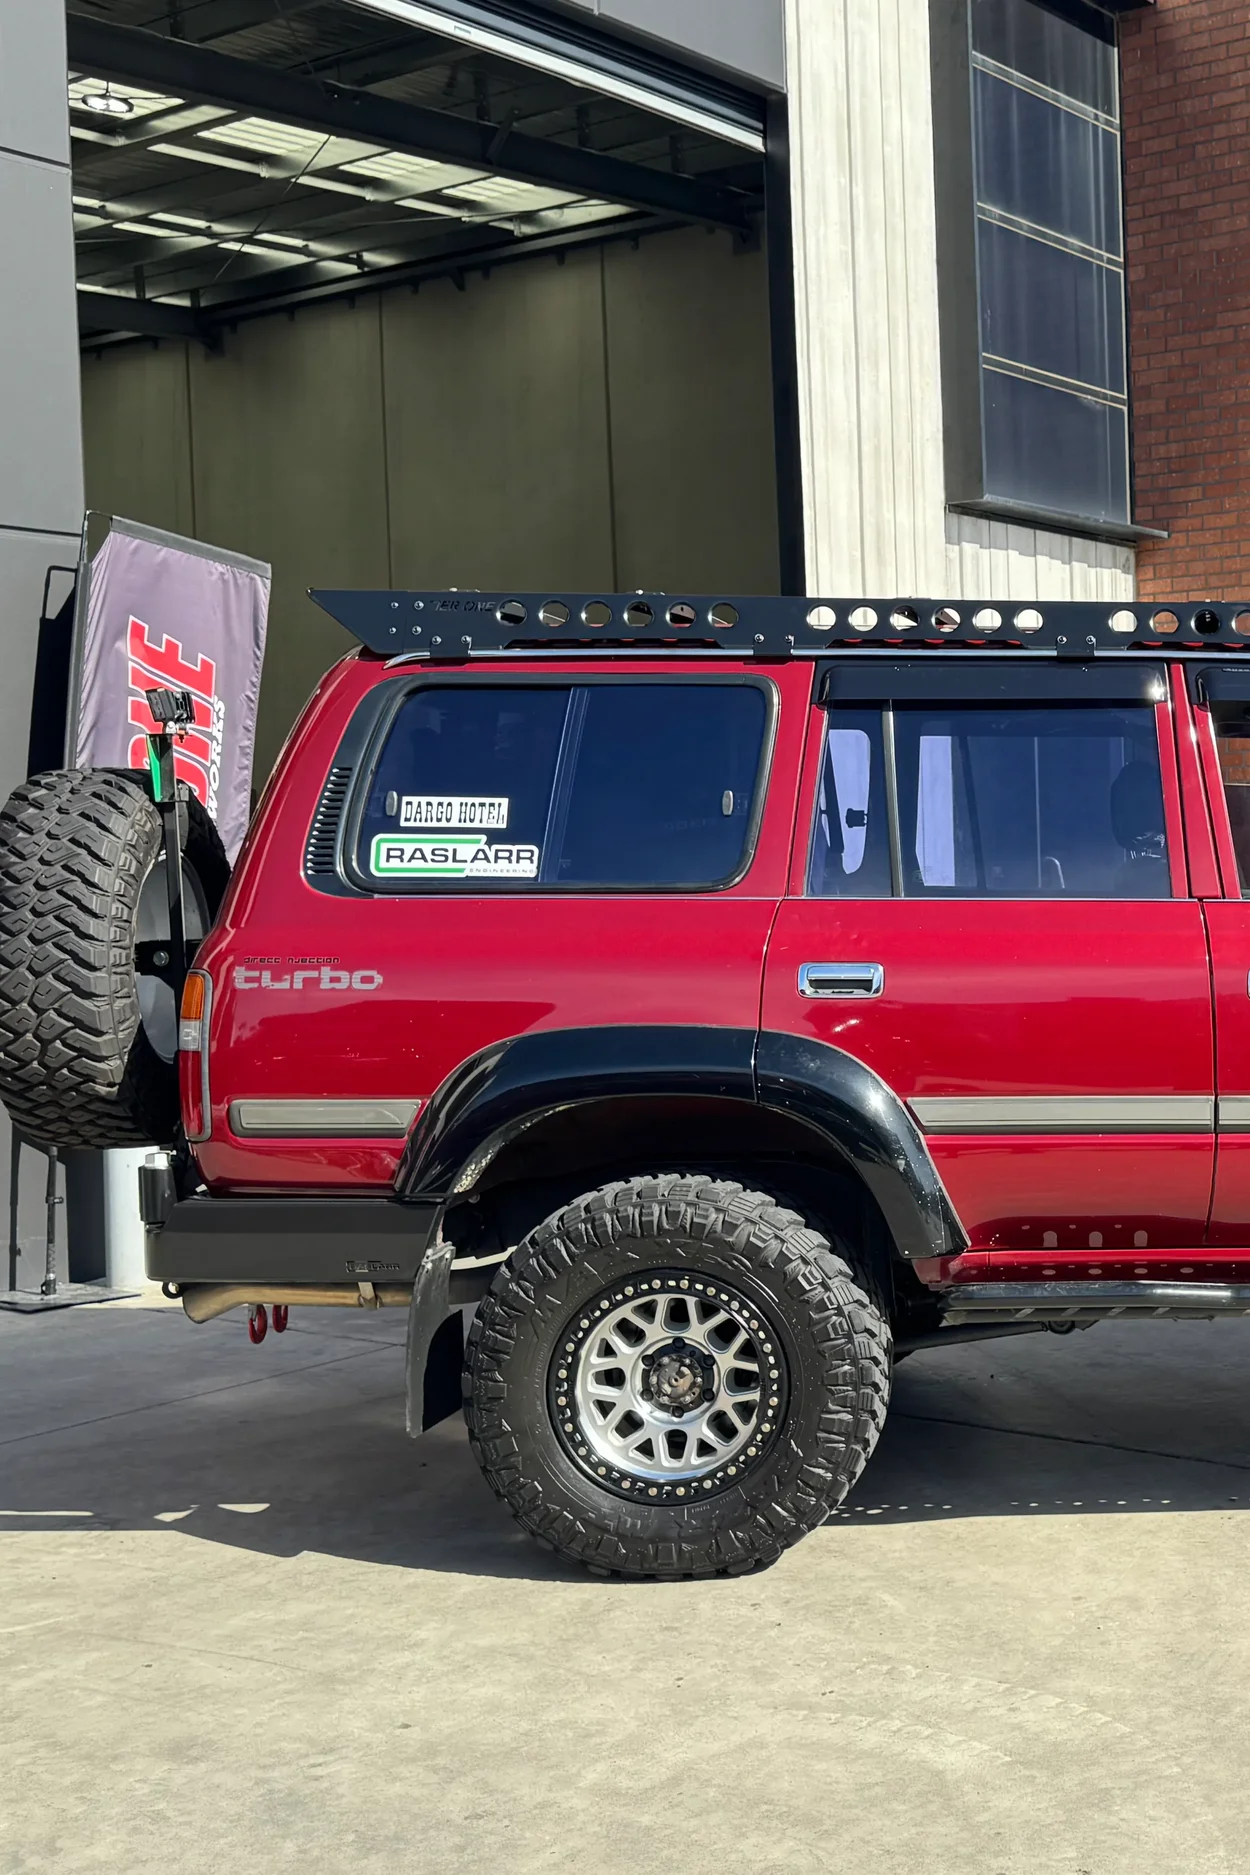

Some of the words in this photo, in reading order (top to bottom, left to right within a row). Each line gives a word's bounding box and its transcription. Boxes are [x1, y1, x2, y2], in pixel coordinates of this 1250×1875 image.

[463, 600, 497, 612] ONE
[206, 694, 226, 820] WORKS
[403, 800, 453, 823] DARGO
[458, 801, 505, 825] HOTEL
[385, 847, 535, 864] RASLARR
[233, 966, 384, 990] turbo
